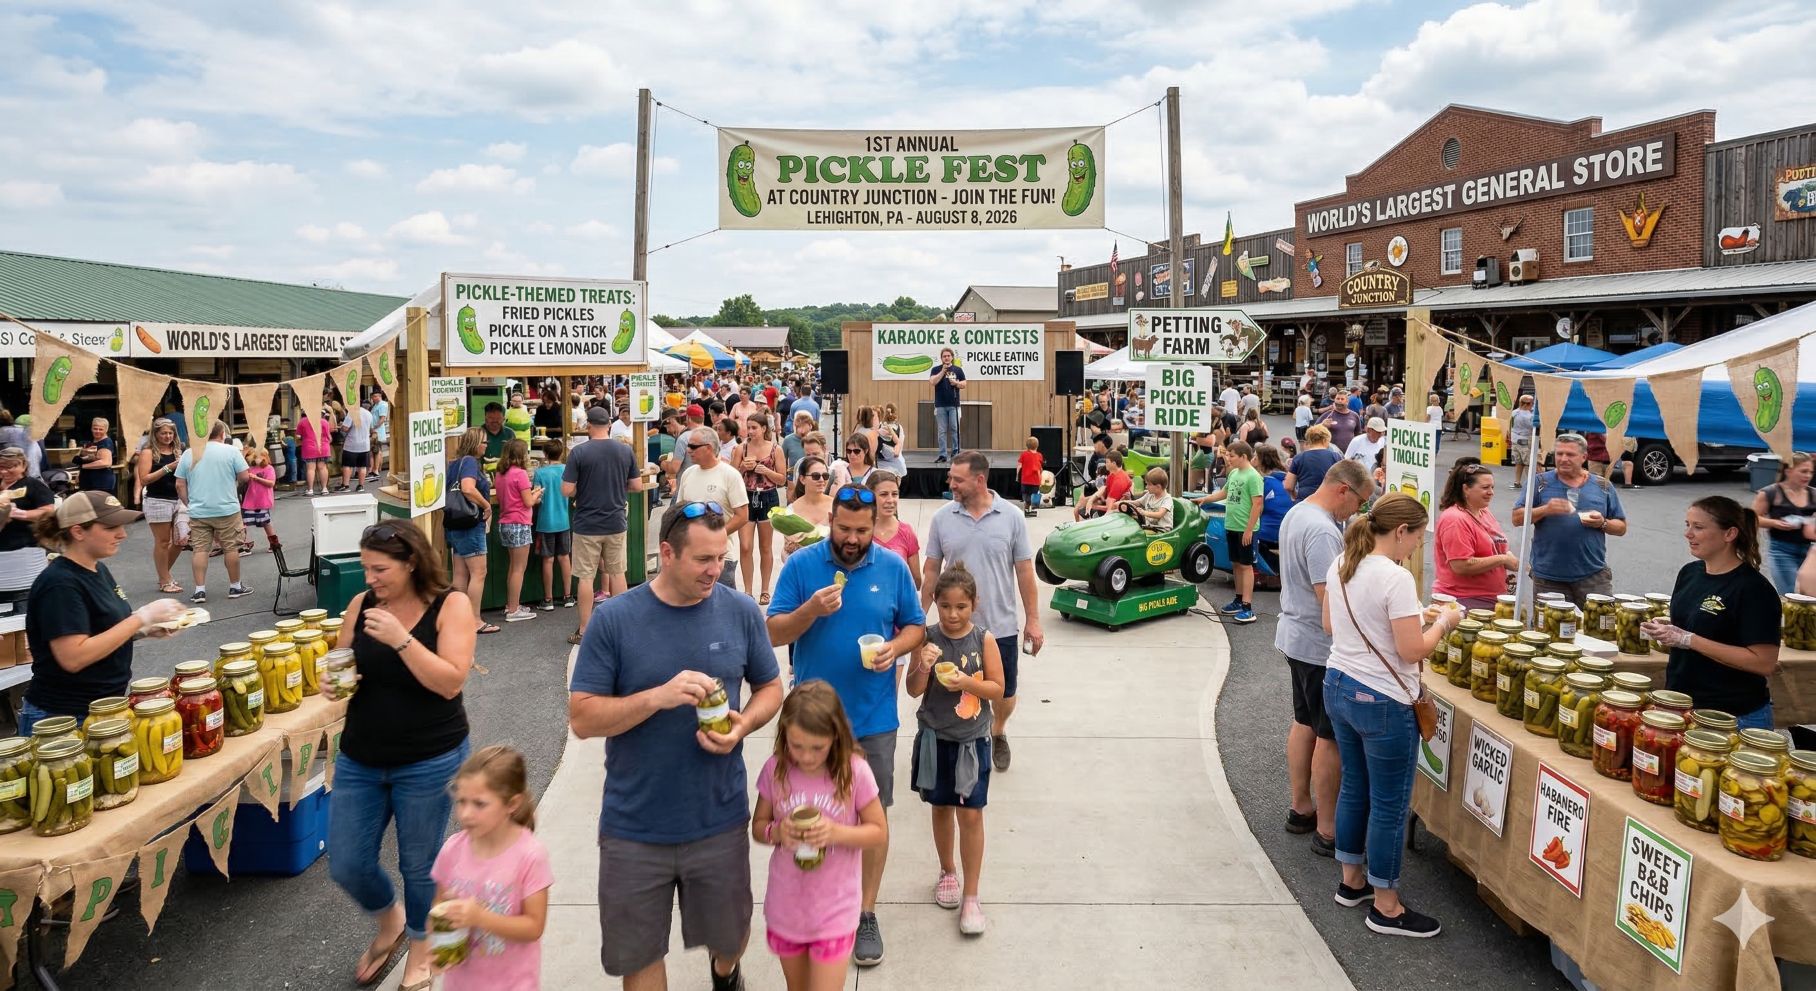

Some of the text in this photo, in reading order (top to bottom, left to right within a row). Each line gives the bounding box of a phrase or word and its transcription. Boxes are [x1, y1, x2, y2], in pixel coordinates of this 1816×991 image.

[865, 136, 959, 152] 1ST ANNUAL
[776, 153, 1047, 184] PICKLE FEST
[767, 189, 786, 205] AT
[789, 189, 860, 205] COUNTRY
[863, 189, 937, 205] JUNCTION
[951, 188, 987, 205] JOIN
[989, 188, 1017, 204] THE
[1021, 188, 1056, 204] FUN!
[1307, 140, 1663, 234] WORLD'S LARGEST GENERAL STORE
[807, 210, 883, 226] LEHIGHTON,
[886, 210, 904, 224] PA
[916, 210, 968, 224] AUGUST
[970, 210, 982, 226] 8,
[985, 210, 1017, 224] 2026
[1346, 273, 1400, 295] COUNTRY
[456, 283, 636, 305] PICKLE-THEMED TREATS:
[1351, 290, 1396, 304] JUNCTION
[502, 306, 594, 321] FRIED PICKLES
[489, 323, 607, 338] PICKLE ON A STICK
[1151, 316, 1222, 334] PETTING
[166, 329, 230, 351] WORLD'S
[234, 332, 289, 352] LARGEST
[292, 335, 338, 352] GENERAL
[877, 329, 1039, 345] KARAOKE & CONTESTS
[1163, 337, 1210, 355] FARM
[490, 341, 607, 356] PICKLE LEMONADE
[966, 351, 1039, 362] PICKLE EATING
[980, 364, 1025, 376] CONTEST
[1162, 369, 1195, 388] BIG
[1150, 389, 1206, 406] PICKLE
[1155, 407, 1200, 427] RIDE
[413, 417, 442, 438] PICKLE
[413, 438, 443, 457] THEMED
[1391, 427, 1431, 450] PICKLE
[1474, 734, 1507, 768] WICKED
[1472, 752, 1504, 785] GARLIC
[1540, 781, 1584, 821] HABANERO
[1547, 804, 1571, 833] FIRE
[1631, 836, 1682, 880] SWEET
[1637, 862, 1669, 896] B&B
[1630, 880, 1674, 923] CHIPS
